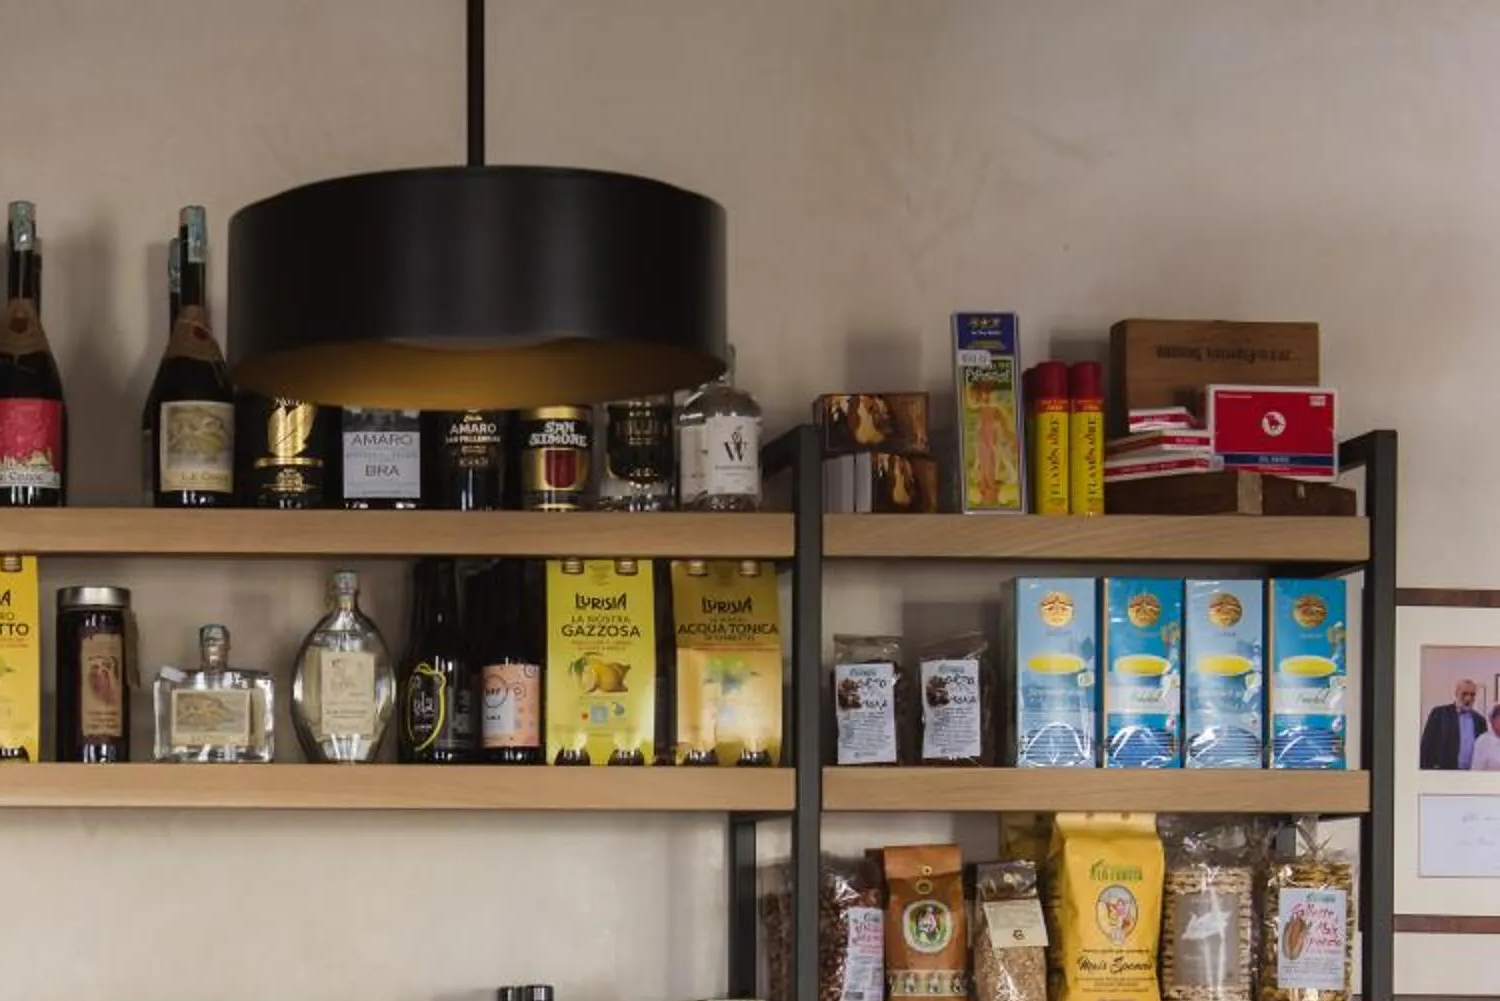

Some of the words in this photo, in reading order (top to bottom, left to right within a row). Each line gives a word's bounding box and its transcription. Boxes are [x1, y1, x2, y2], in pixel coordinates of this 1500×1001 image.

[450, 423, 497, 435] AMARO
[351, 432, 413, 447] AMARO
[364, 462, 401, 478] BRA
[575, 592, 628, 611] LURISIA
[701, 595, 753, 614] LURISIA
[561, 624, 641, 638] GAZZOSA
[677, 623, 725, 635] ACQUA
[728, 623, 779, 635] TONICA
